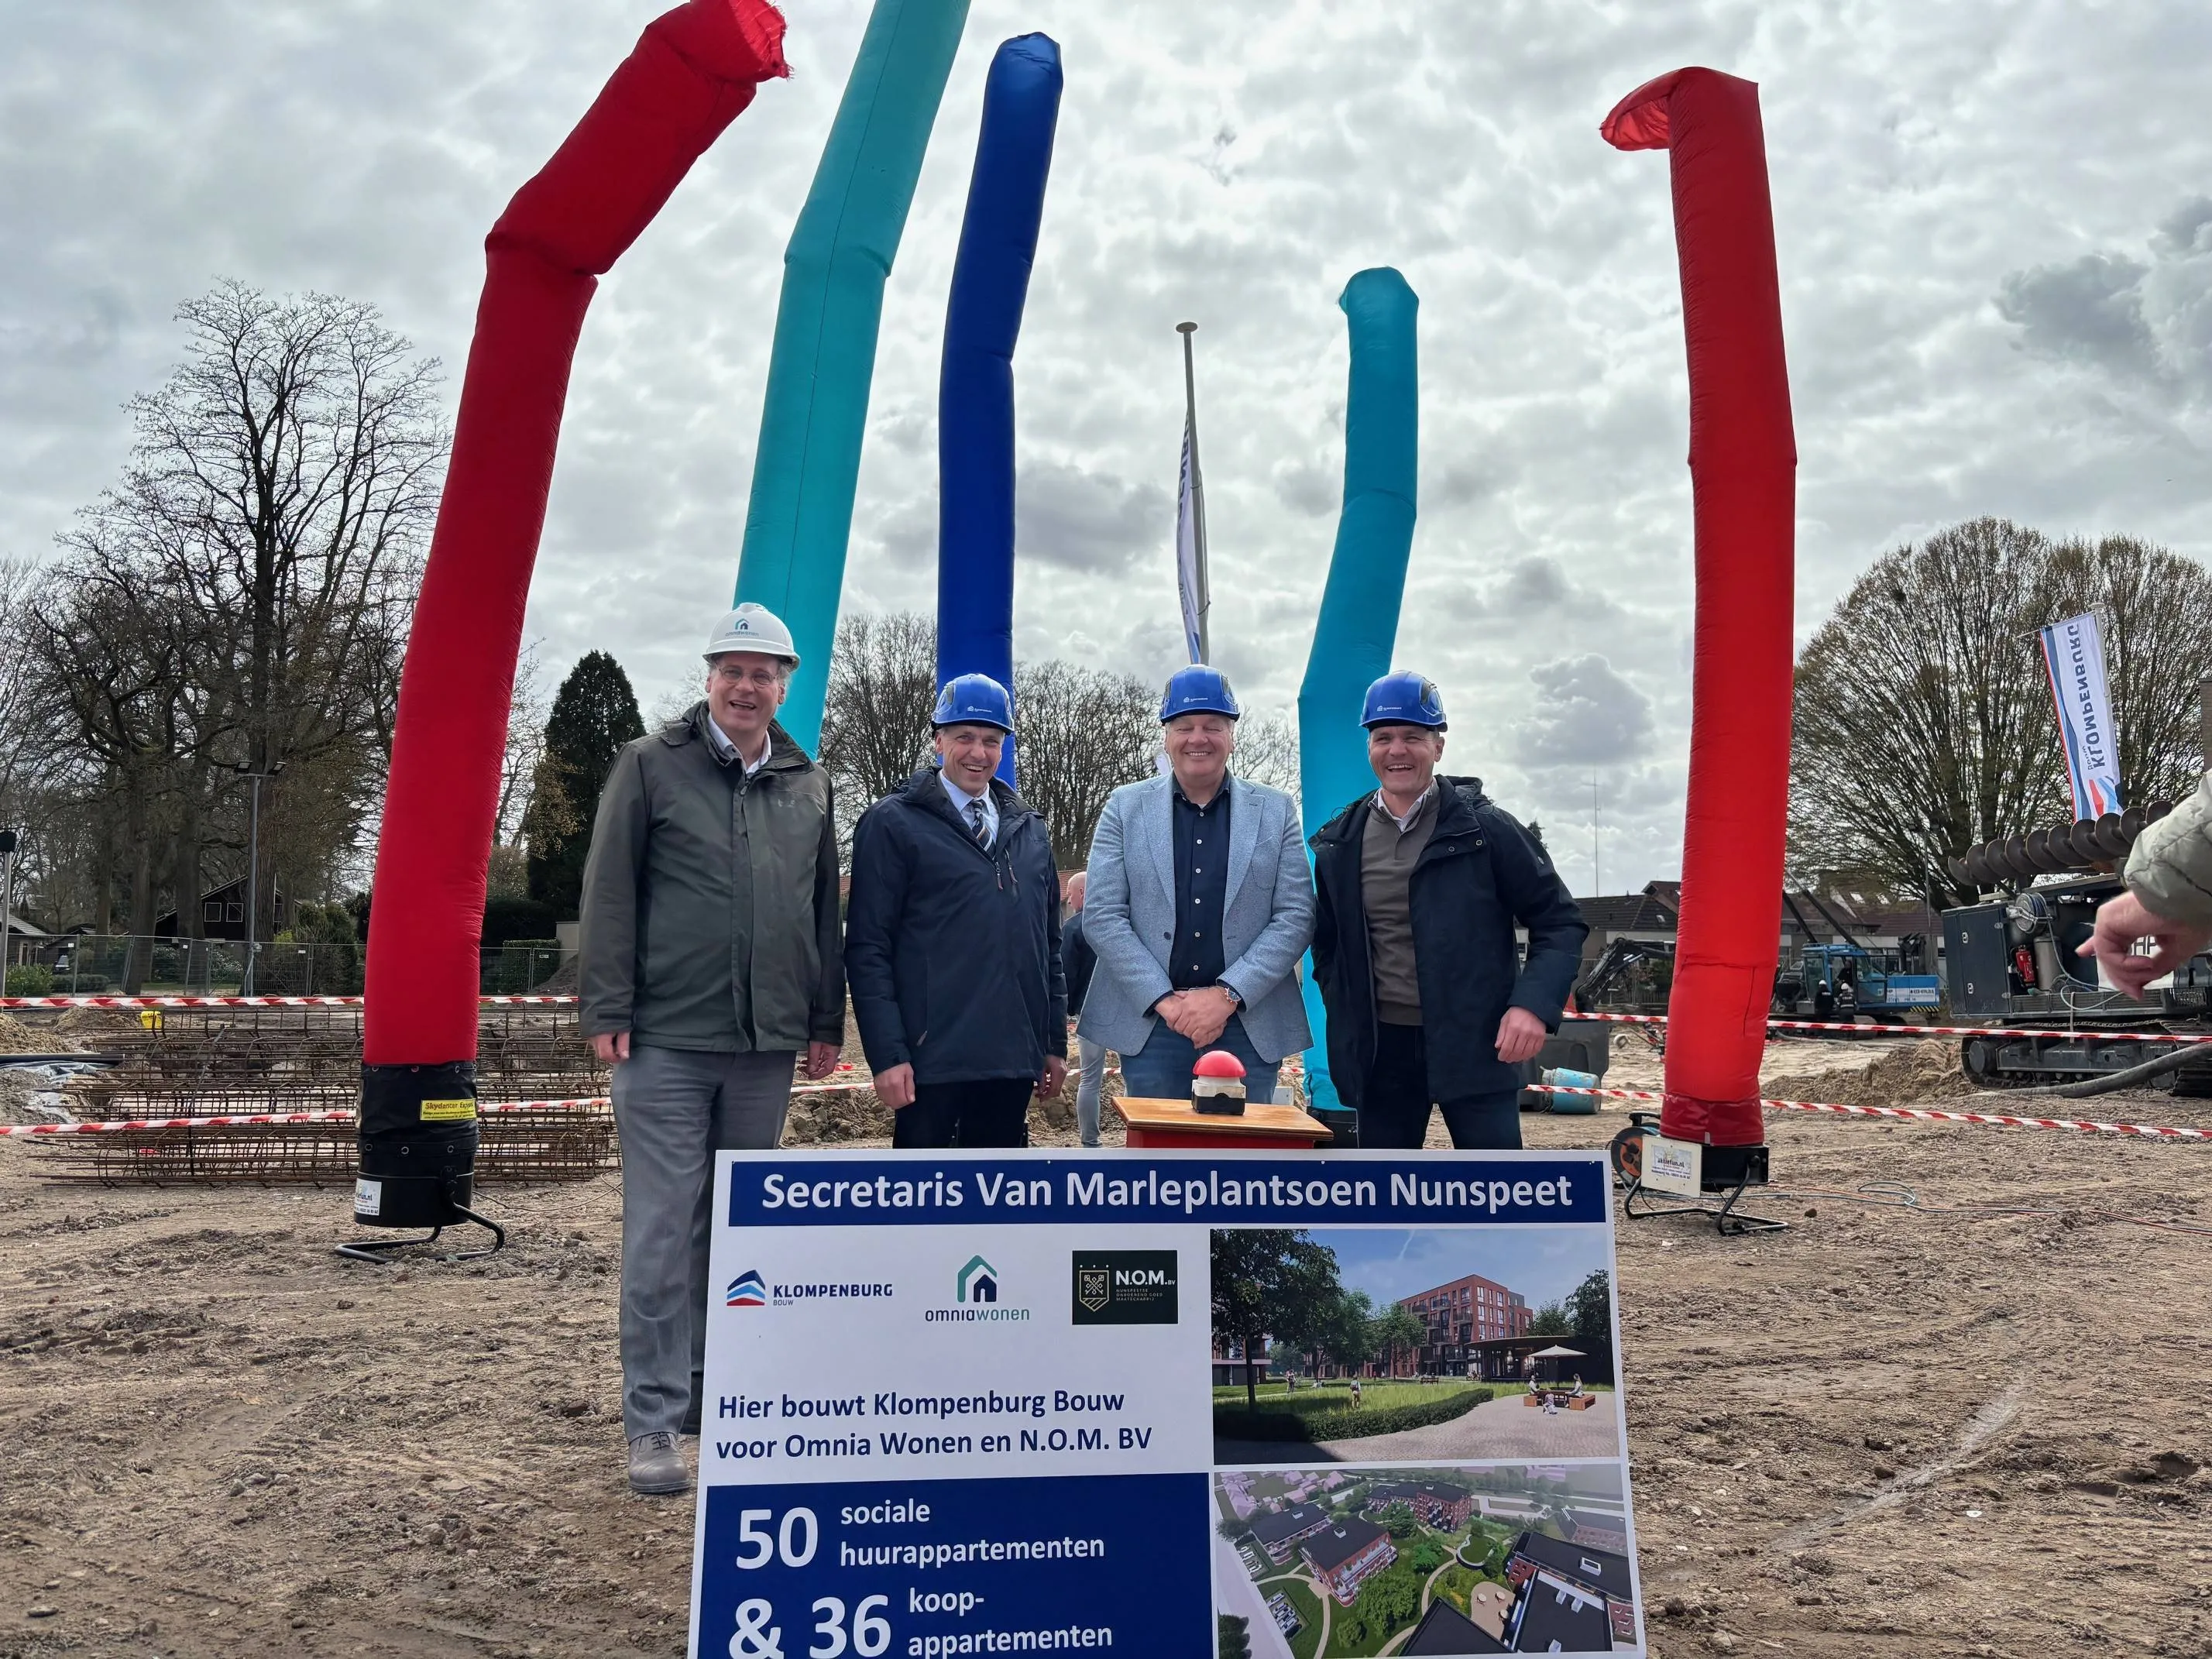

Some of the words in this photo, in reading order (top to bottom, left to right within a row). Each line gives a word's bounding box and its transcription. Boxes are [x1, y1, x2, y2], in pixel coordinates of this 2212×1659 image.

[762, 1171, 963, 1208] Secretaris
[975, 1173, 1052, 1206] Van
[1066, 1170, 1376, 1214] Marleplantsoen
[1390, 1173, 1573, 1214] Nunspeet
[773, 1283, 893, 1298] KLOMPENBURG
[925, 1309, 1030, 1322] omniawonen
[719, 1395, 774, 1419] Hier
[781, 1393, 866, 1417] bouwt
[874, 1389, 1046, 1420] Klompenburg
[1054, 1389, 1125, 1412] Bouw
[716, 1440, 778, 1459] voor
[785, 1432, 871, 1458] Omnia
[879, 1432, 972, 1455] Wonen
[981, 1435, 1011, 1453] en
[1020, 1428, 1110, 1451] N.O.M.
[1119, 1427, 1152, 1450] BV
[840, 1498, 930, 1525] sociale
[736, 1506, 819, 1570] 50
[840, 1537, 1104, 1569] huurappartementen
[909, 1587, 984, 1617] koop-
[728, 1598, 785, 1659] &
[809, 1594, 891, 1659] 36
[908, 1625, 1112, 1659] appartementen
